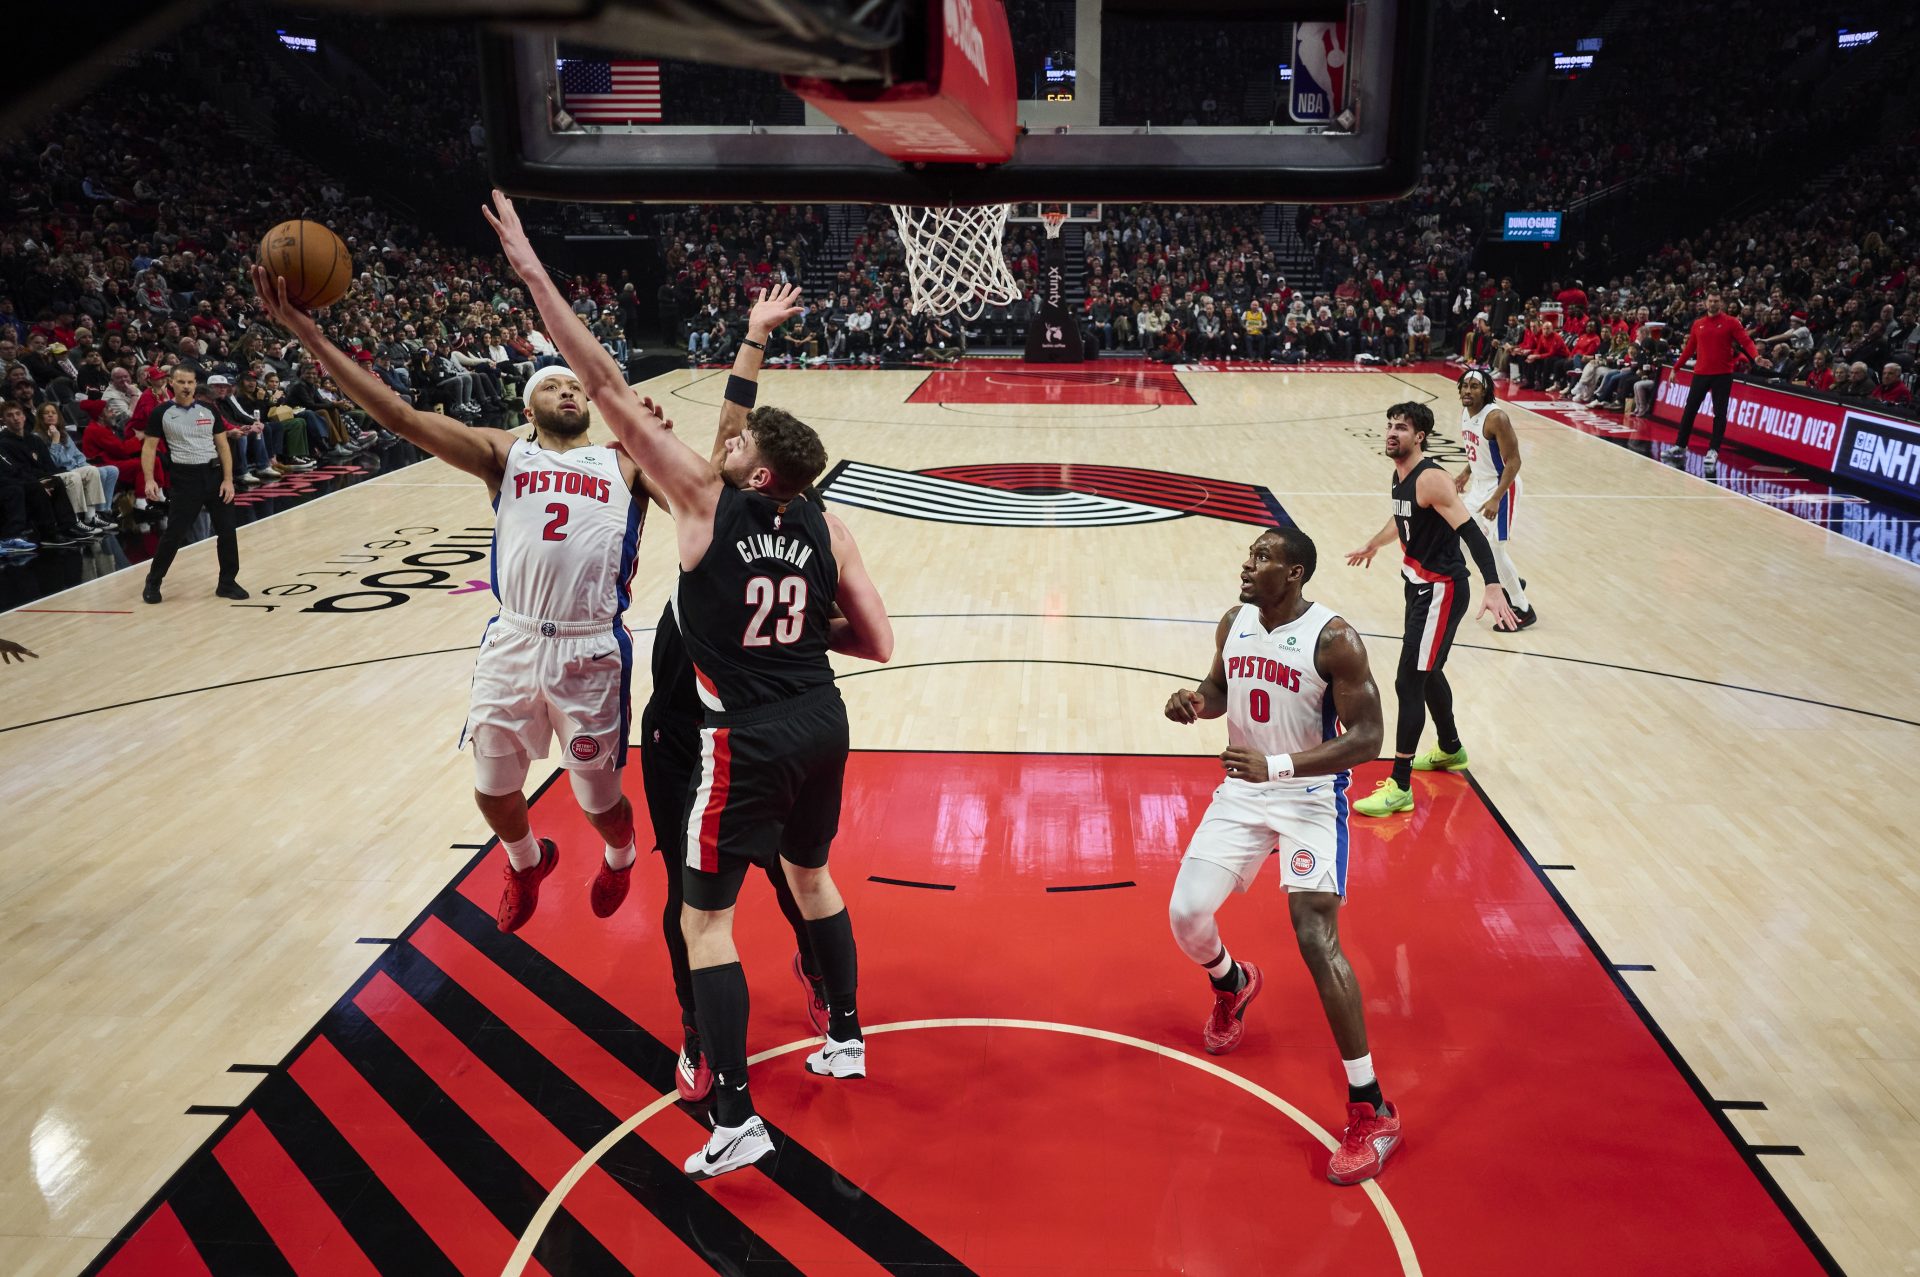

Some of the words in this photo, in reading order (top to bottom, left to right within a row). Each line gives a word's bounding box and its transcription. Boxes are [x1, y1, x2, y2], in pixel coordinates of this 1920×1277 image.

[1298, 93, 1323, 113] NBA
[1508, 217, 1529, 228] DUNK
[1535, 217, 1557, 229] GAME
[1047, 266, 1062, 308] xfinity
[1737, 400, 1760, 428] GET
[1758, 405, 1802, 441] PULLED
[1802, 416, 1836, 451] OVER
[514, 471, 611, 503] PISTONS
[543, 503, 569, 541] 2
[230, 526, 440, 613] center
[736, 533, 813, 570] CLINGAN
[742, 575, 808, 648] 23
[1228, 655, 1302, 693] PISTONS
[1249, 688, 1271, 723] 0
